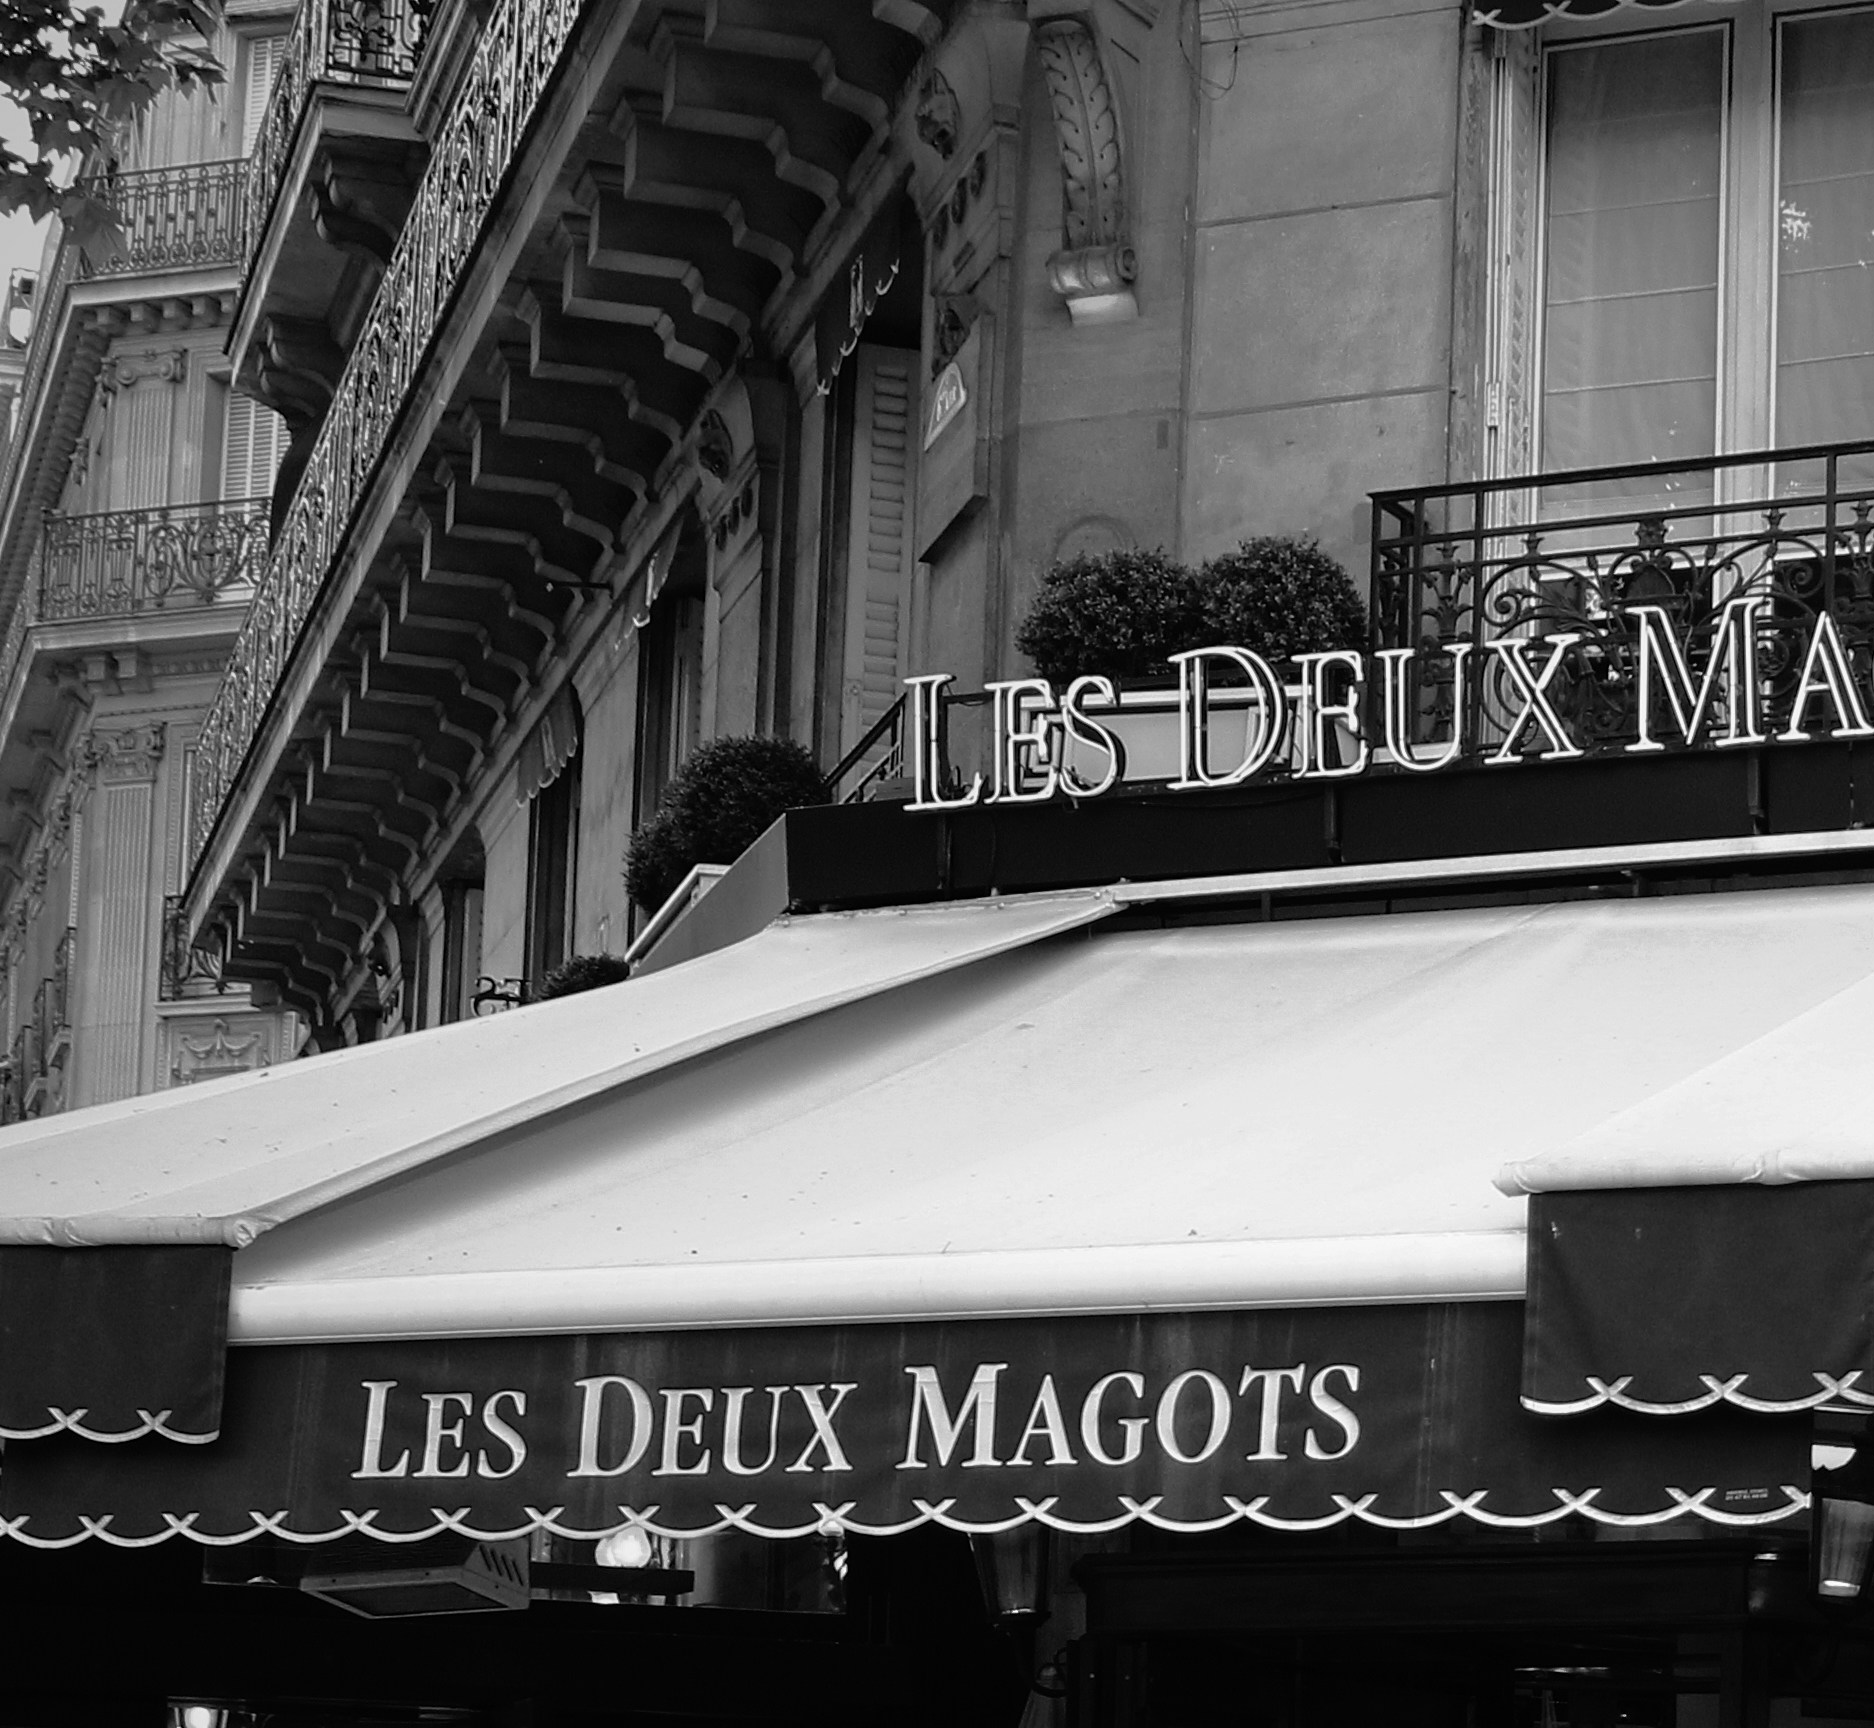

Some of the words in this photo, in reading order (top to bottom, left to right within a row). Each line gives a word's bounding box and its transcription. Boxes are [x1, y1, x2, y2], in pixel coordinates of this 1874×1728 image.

[903, 673, 1125, 811] LES
[1166, 644, 1584, 791] DEUX
[351, 1380, 527, 1479] LES
[566, 1375, 858, 1477] DEUX
[895, 1362, 1361, 1470] MAGOTS
